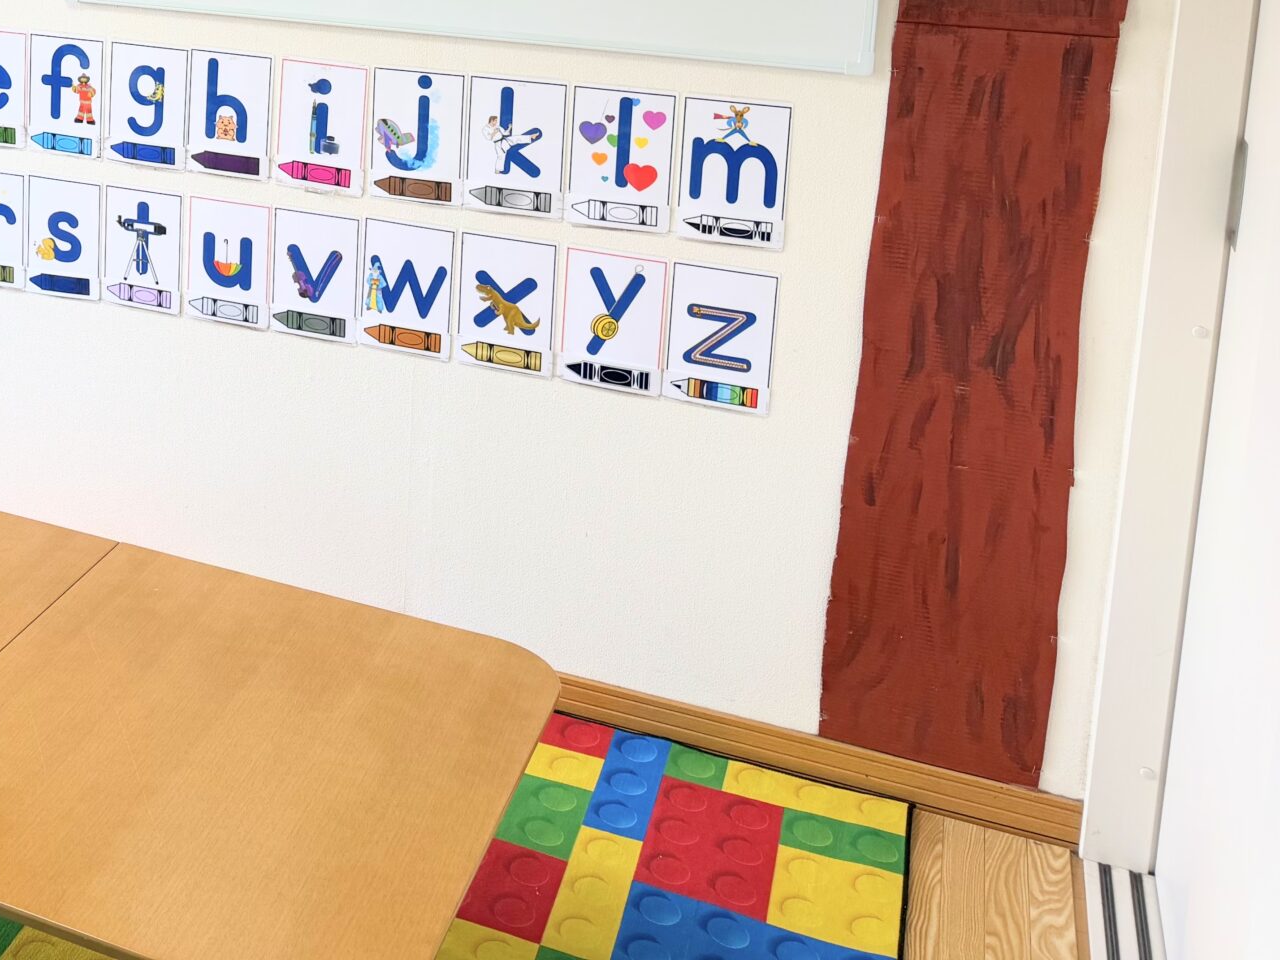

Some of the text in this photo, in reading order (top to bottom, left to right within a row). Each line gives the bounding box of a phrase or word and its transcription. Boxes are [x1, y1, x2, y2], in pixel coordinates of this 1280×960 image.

[41, 43, 90, 120] f
[127, 64, 166, 137] g
[205, 57, 248, 144] h
[309, 78, 333, 155] i
[385, 74, 434, 172] j
[498, 86, 543, 178] k
[689, 136, 779, 210] m
[47, 211, 82, 263] s
[124, 201, 165, 276] t
[202, 231, 253, 292] u
[287, 243, 343, 304] v
[369, 254, 448, 319] w
[473, 269, 538, 336] x
[585, 265, 646, 356] y
[682, 302, 757, 373] z
